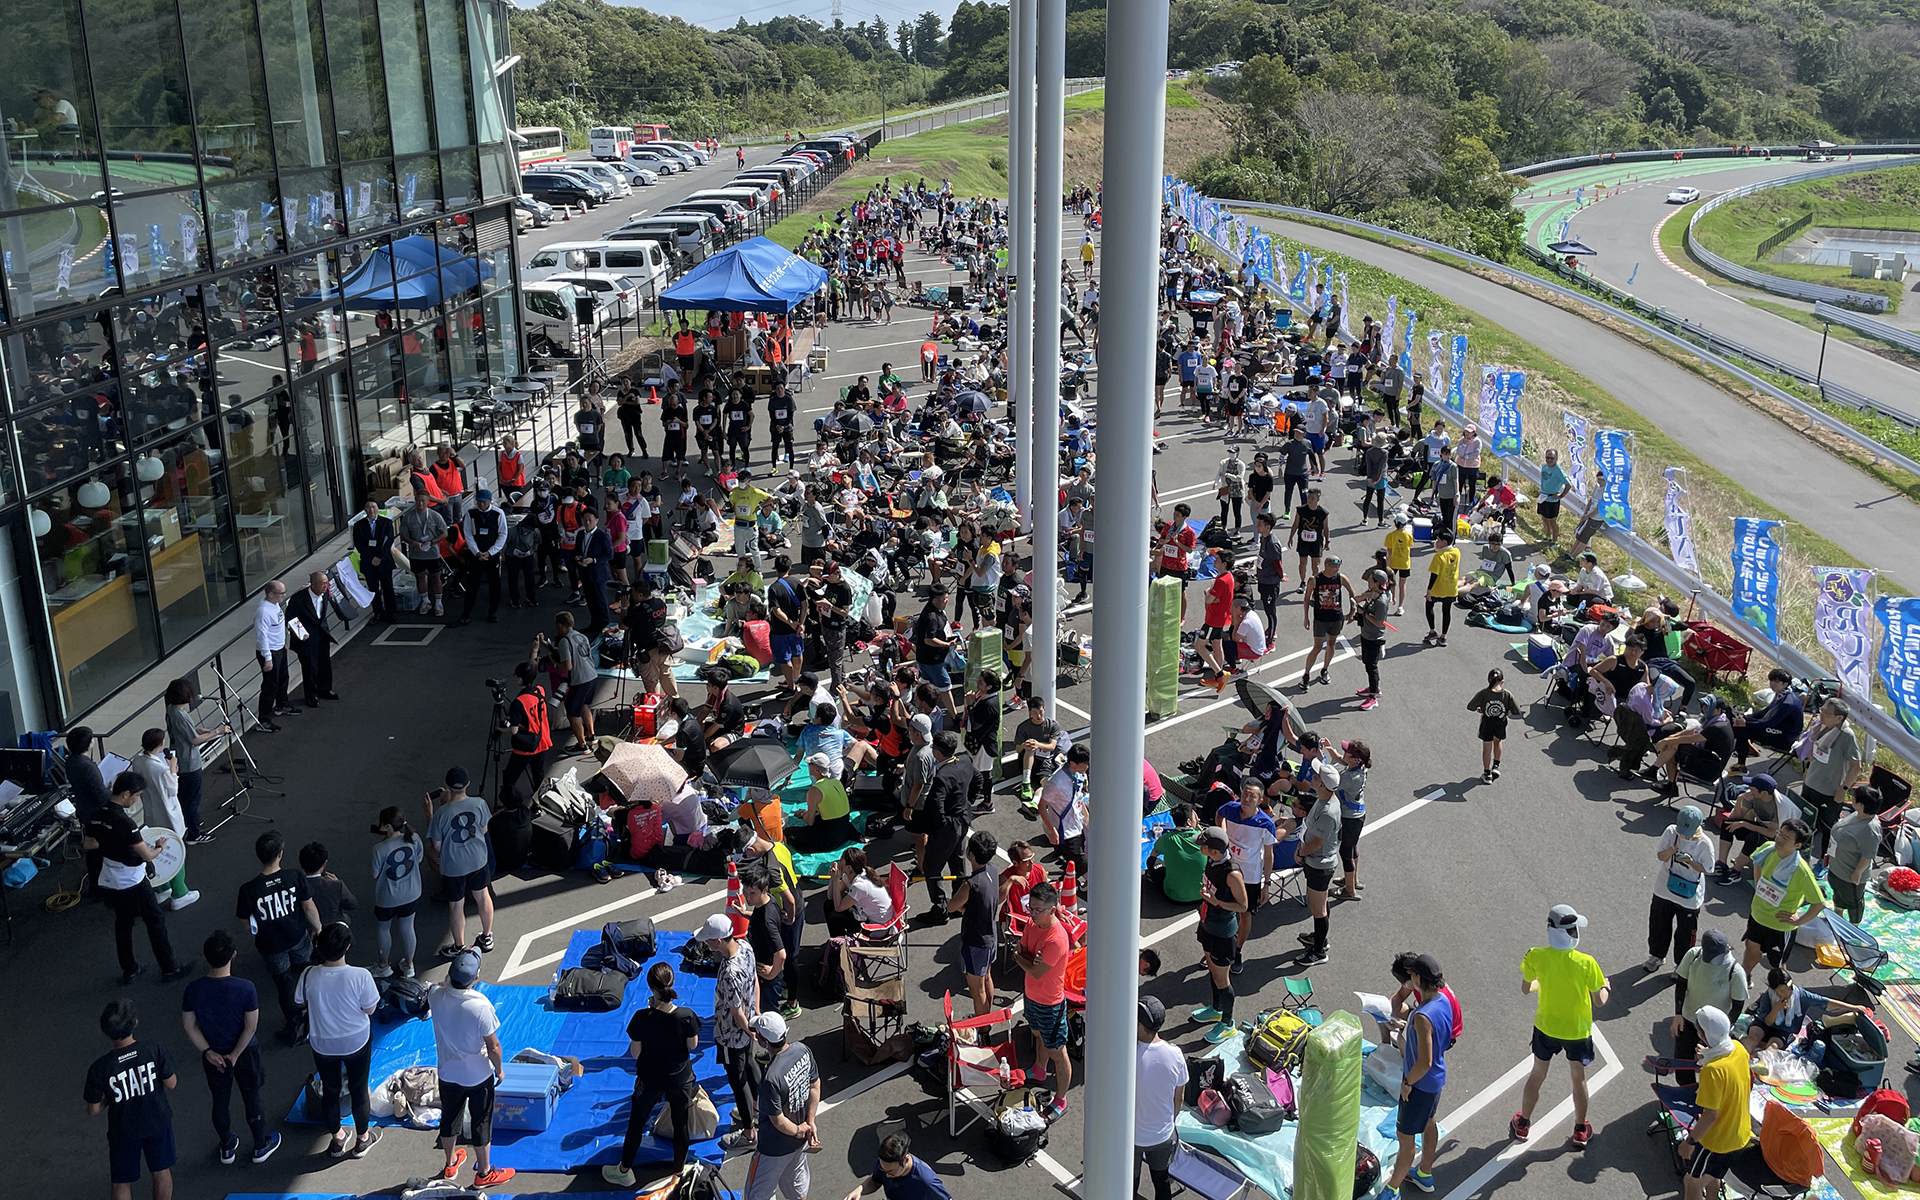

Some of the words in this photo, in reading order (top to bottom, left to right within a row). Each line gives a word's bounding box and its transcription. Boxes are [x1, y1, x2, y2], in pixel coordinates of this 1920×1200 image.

[451, 811, 476, 843] 8
[385, 846, 415, 881] 8
[256, 886, 297, 921] STAFF
[109, 1061, 158, 1104] STAFF
